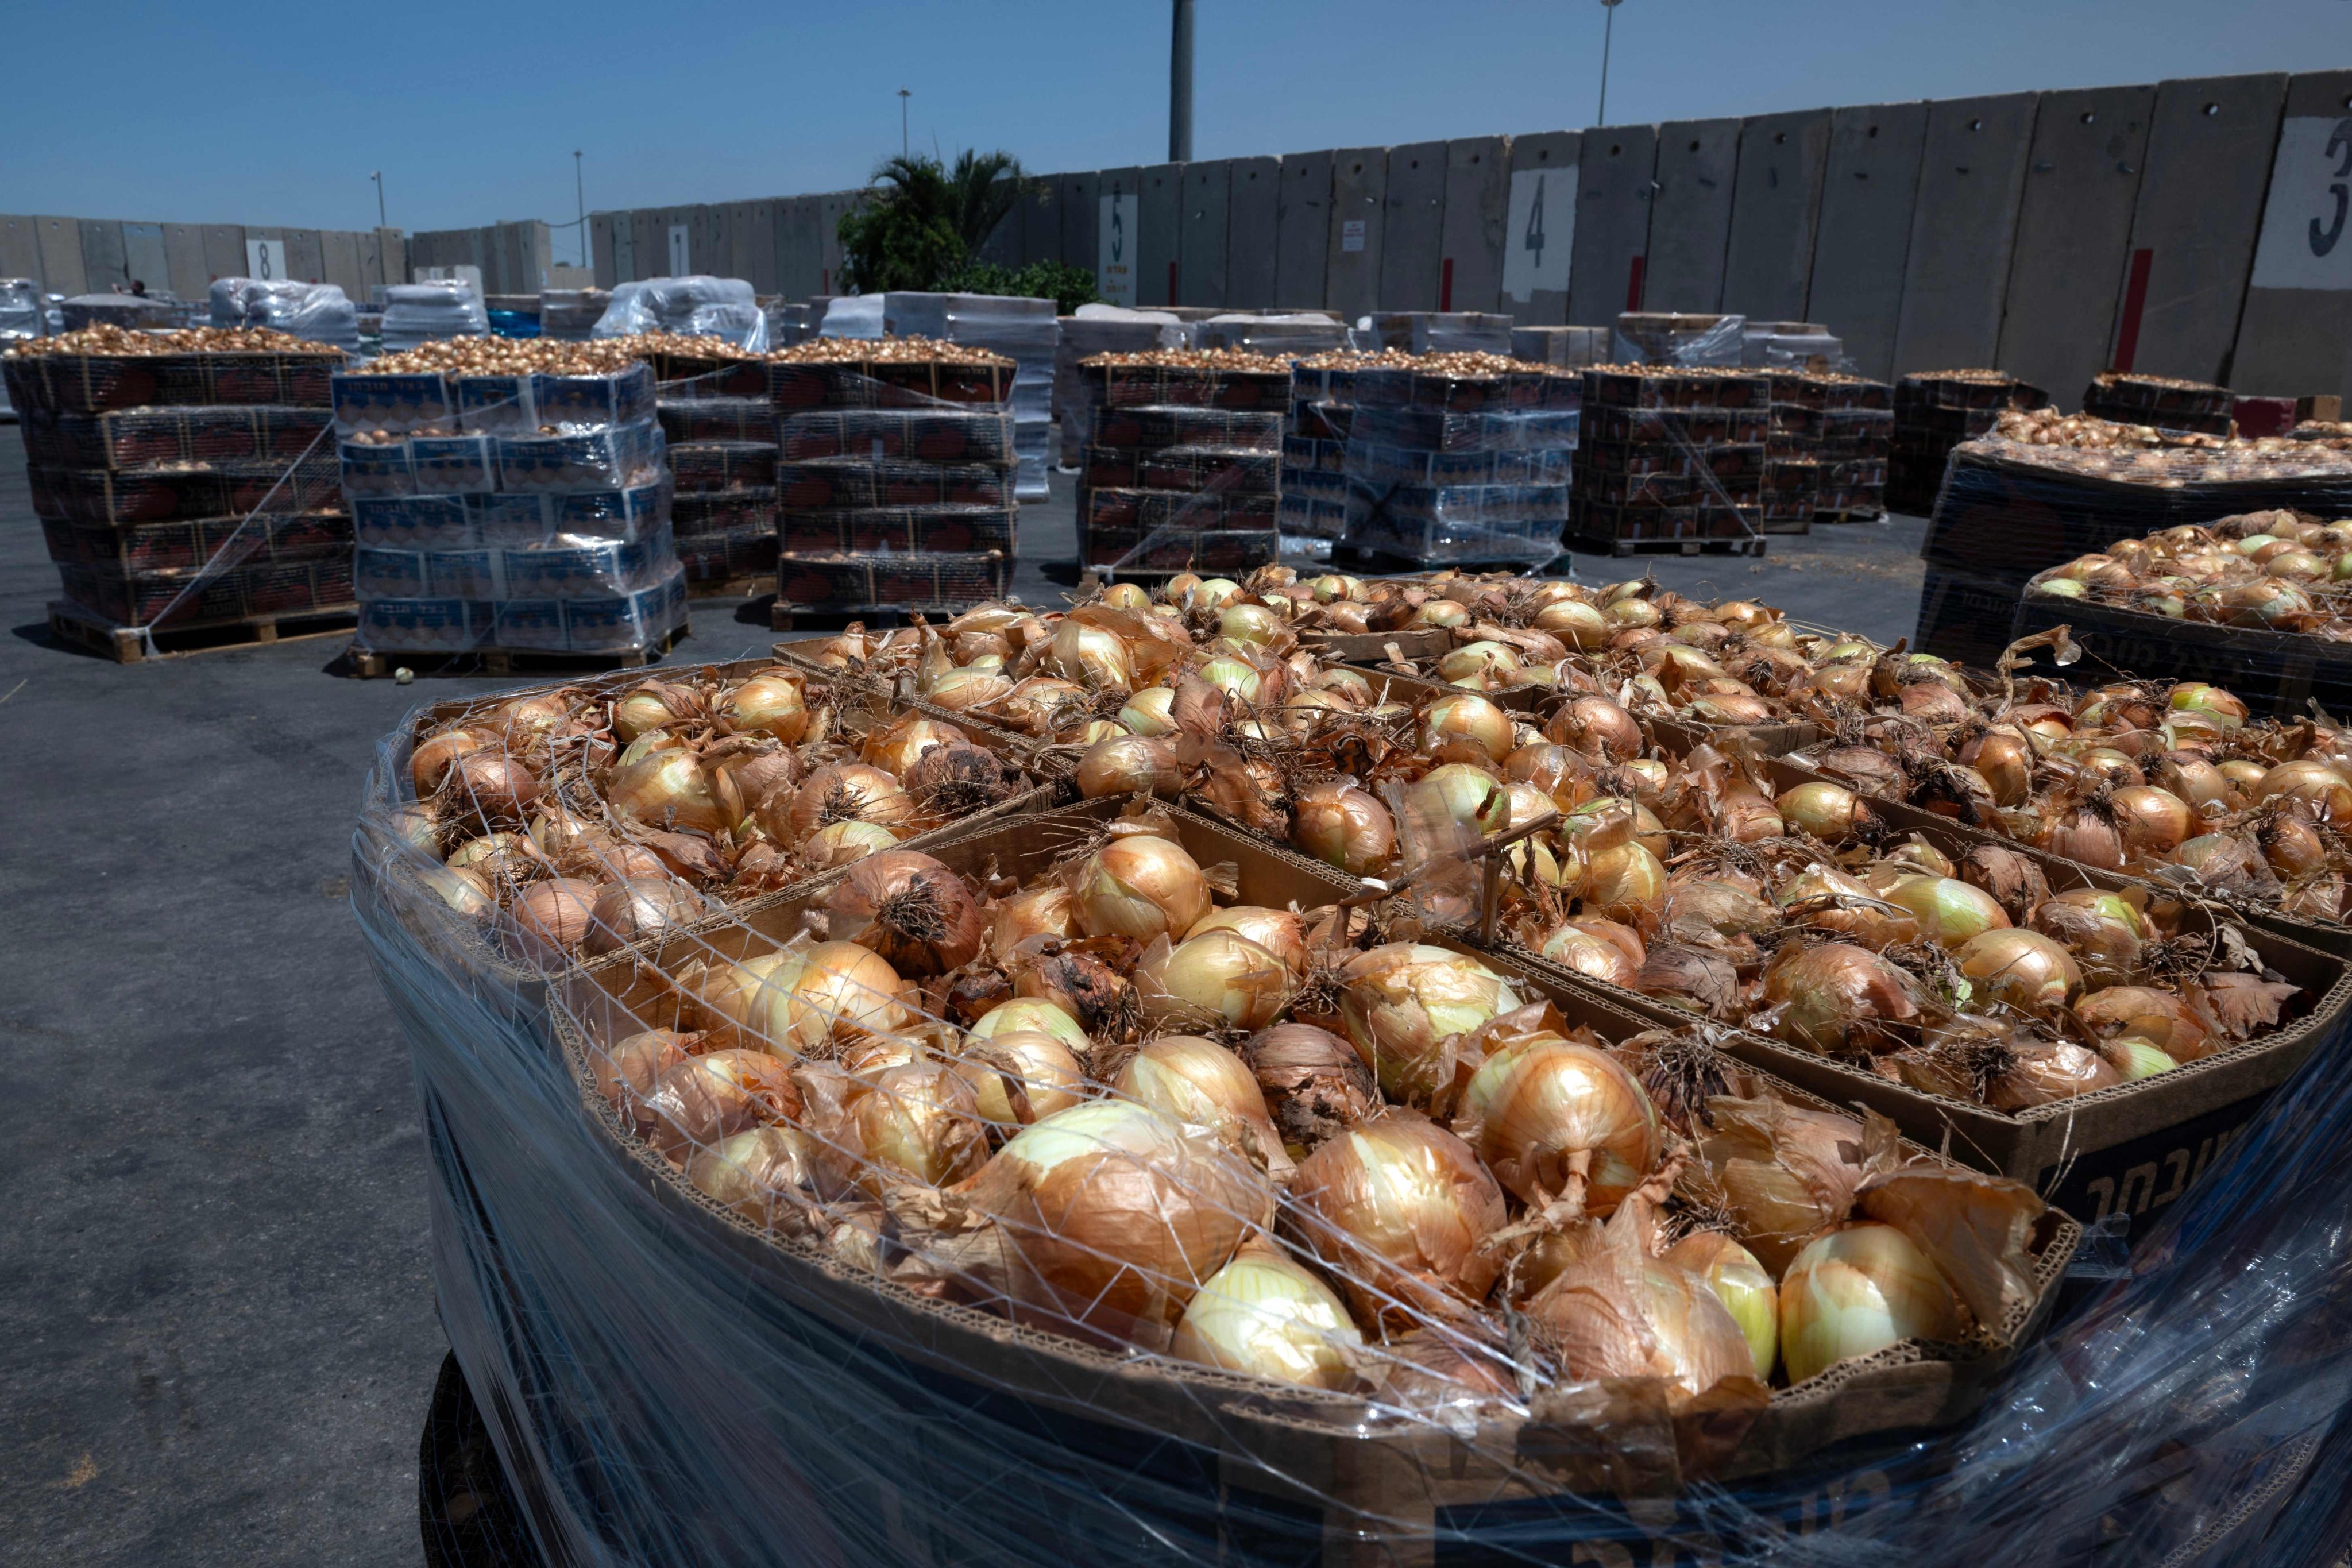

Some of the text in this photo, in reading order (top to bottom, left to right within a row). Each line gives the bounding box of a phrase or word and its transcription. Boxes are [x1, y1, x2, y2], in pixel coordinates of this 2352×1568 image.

[2309, 119, 2352, 257] 3
[1112, 189, 1122, 262] 5
[1525, 174, 1545, 268] 4
[259, 242, 271, 280] 8
[345, 379, 426, 391] בצל מובחר
[971, 366, 987, 375] בצל
[367, 503, 410, 514] מובחר
[375, 603, 447, 615] בצל מובחר
[2169, 640, 2243, 685] בצל
